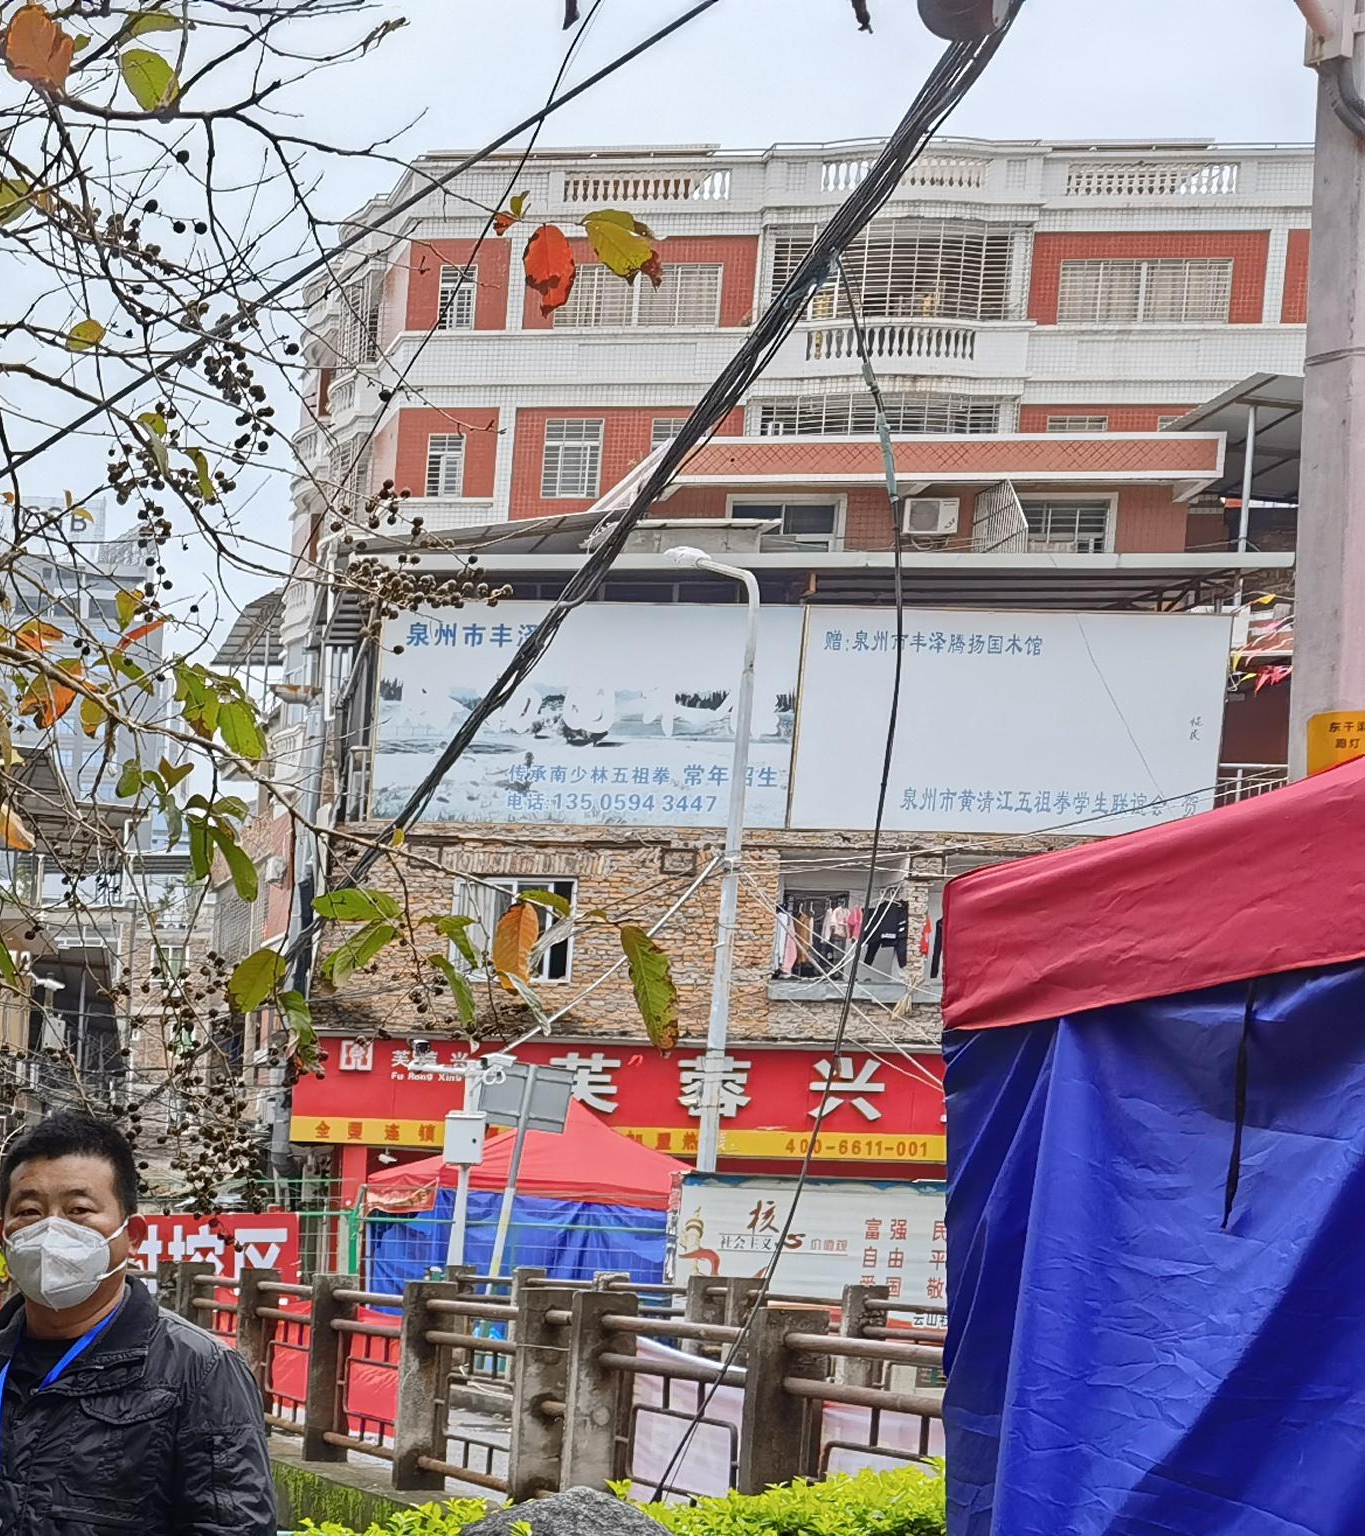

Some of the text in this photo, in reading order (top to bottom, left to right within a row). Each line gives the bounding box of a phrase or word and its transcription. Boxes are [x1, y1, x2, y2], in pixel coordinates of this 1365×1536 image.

[600, 794, 655, 812] 0594
[662, 796, 717, 813] 3447
[785, 1138, 929, 1158] 400-6611-001
